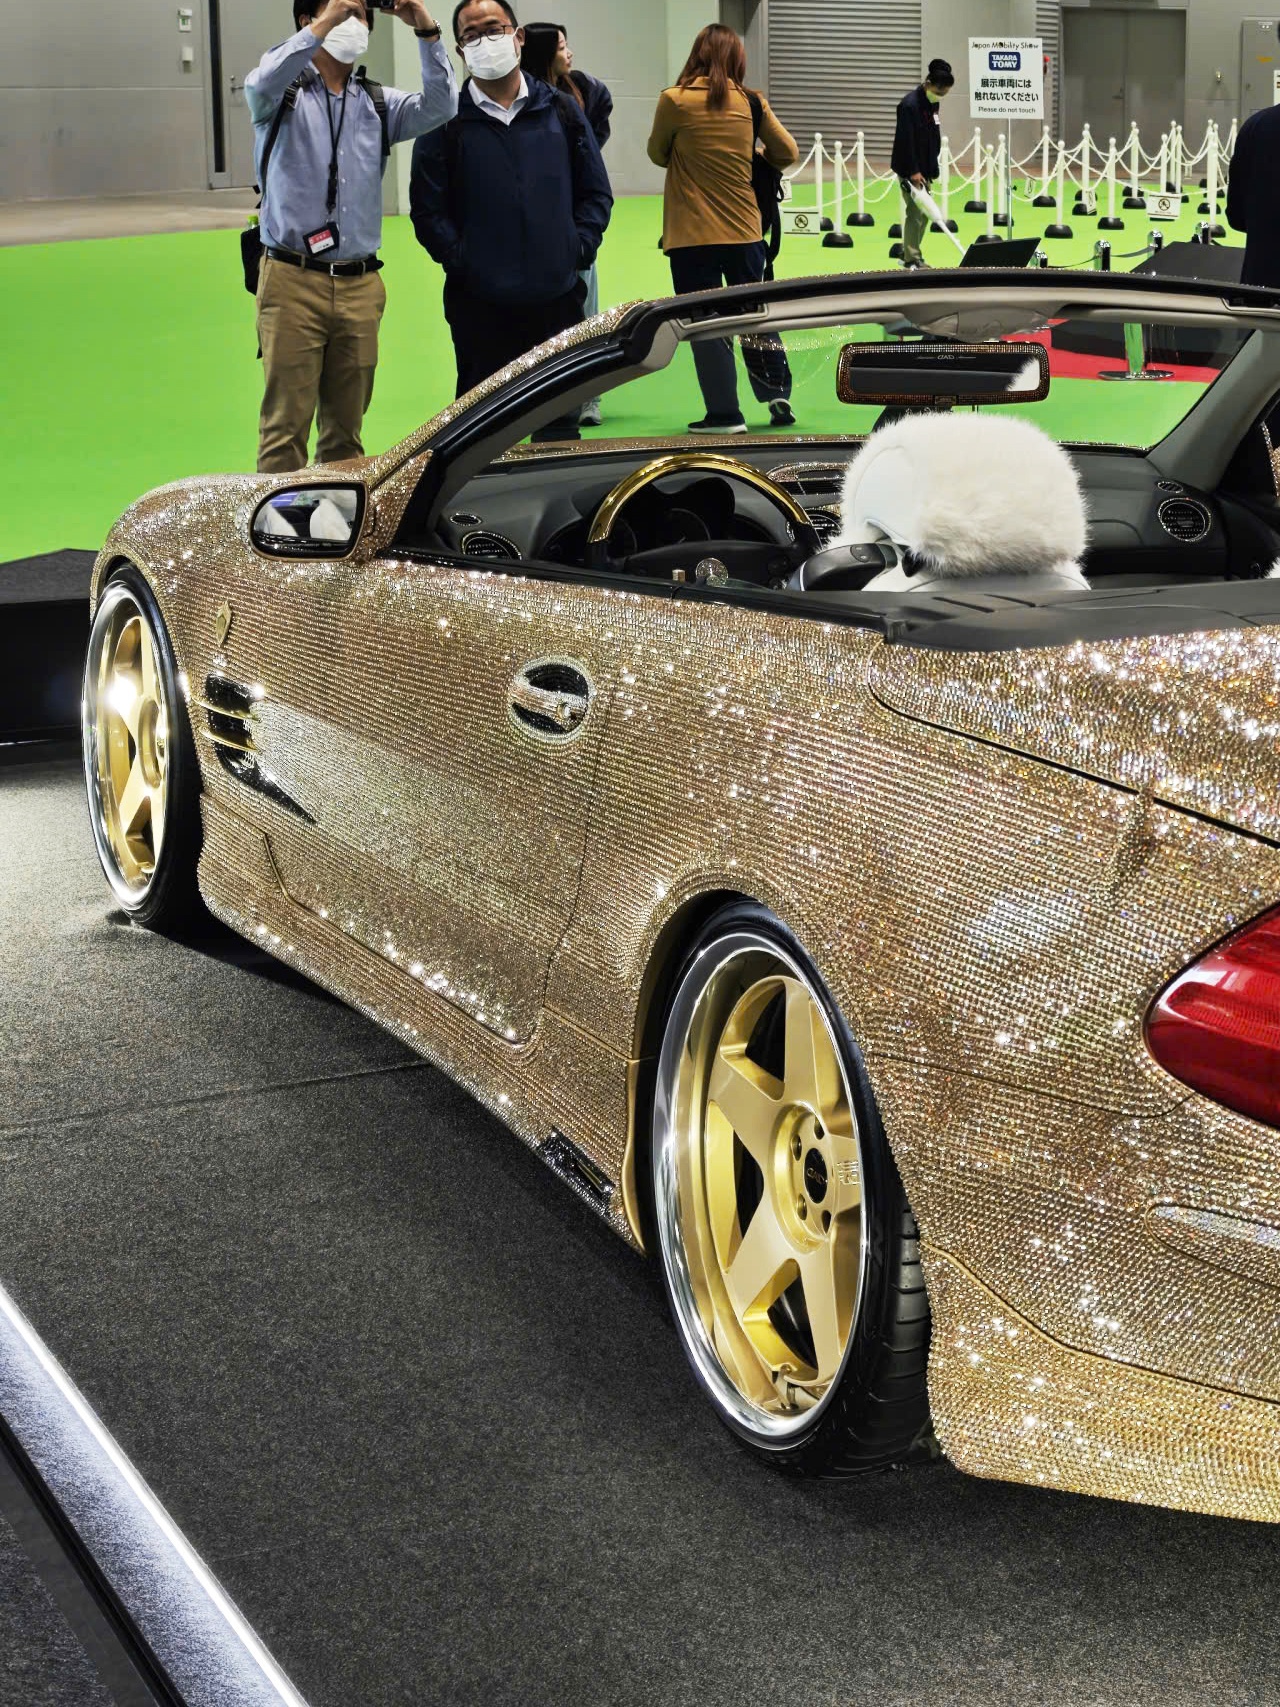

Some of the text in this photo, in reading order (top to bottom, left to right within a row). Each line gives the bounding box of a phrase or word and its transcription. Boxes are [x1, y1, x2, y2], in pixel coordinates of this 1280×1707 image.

[972, 41, 990, 50] Japan
[992, 41, 1019, 50] Mobility
[981, 78, 1032, 88] 展示車両には
[975, 91, 1039, 101] 触れないでください
